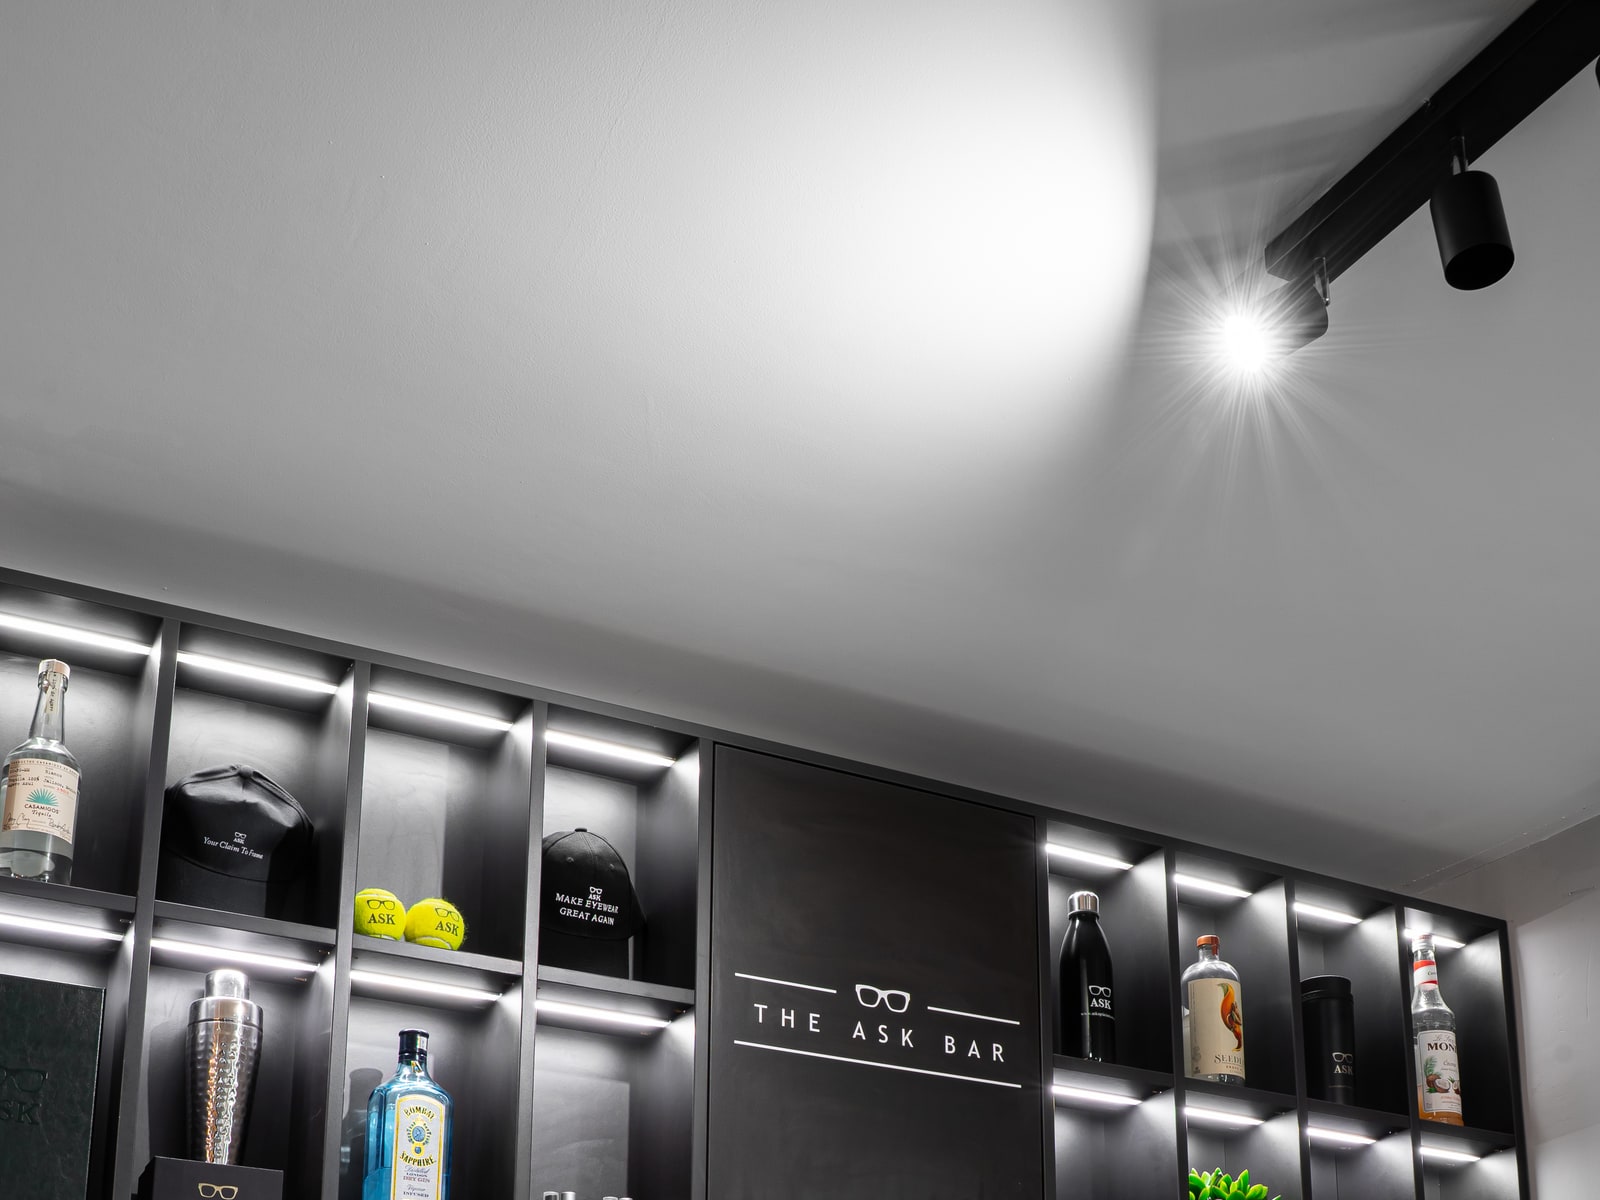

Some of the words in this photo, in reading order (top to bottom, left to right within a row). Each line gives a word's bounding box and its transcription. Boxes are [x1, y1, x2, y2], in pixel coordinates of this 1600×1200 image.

[24, 803, 59, 815] CASAMIGOS
[32, 809, 52, 818] Tequila
[204, 836, 219, 846] Your
[220, 841, 240, 852] Claim
[241, 846, 248, 855] To
[556, 892, 584, 906] MAKE
[586, 900, 618, 914] EYEWEAR
[368, 913, 396, 925] ASK
[560, 907, 590, 920] GREAT
[591, 914, 615, 926] AGAIN
[435, 921, 459, 937] ASK
[1090, 997, 1112, 1010] ASK
[754, 1003, 820, 1032] THE
[852, 1021, 914, 1048] ASK
[945, 1035, 1004, 1062] BAR
[1427, 1042, 1457, 1053] MON
[1333, 1064, 1354, 1076] ASK
[400, 1151, 435, 1166] SAPPHIRE
